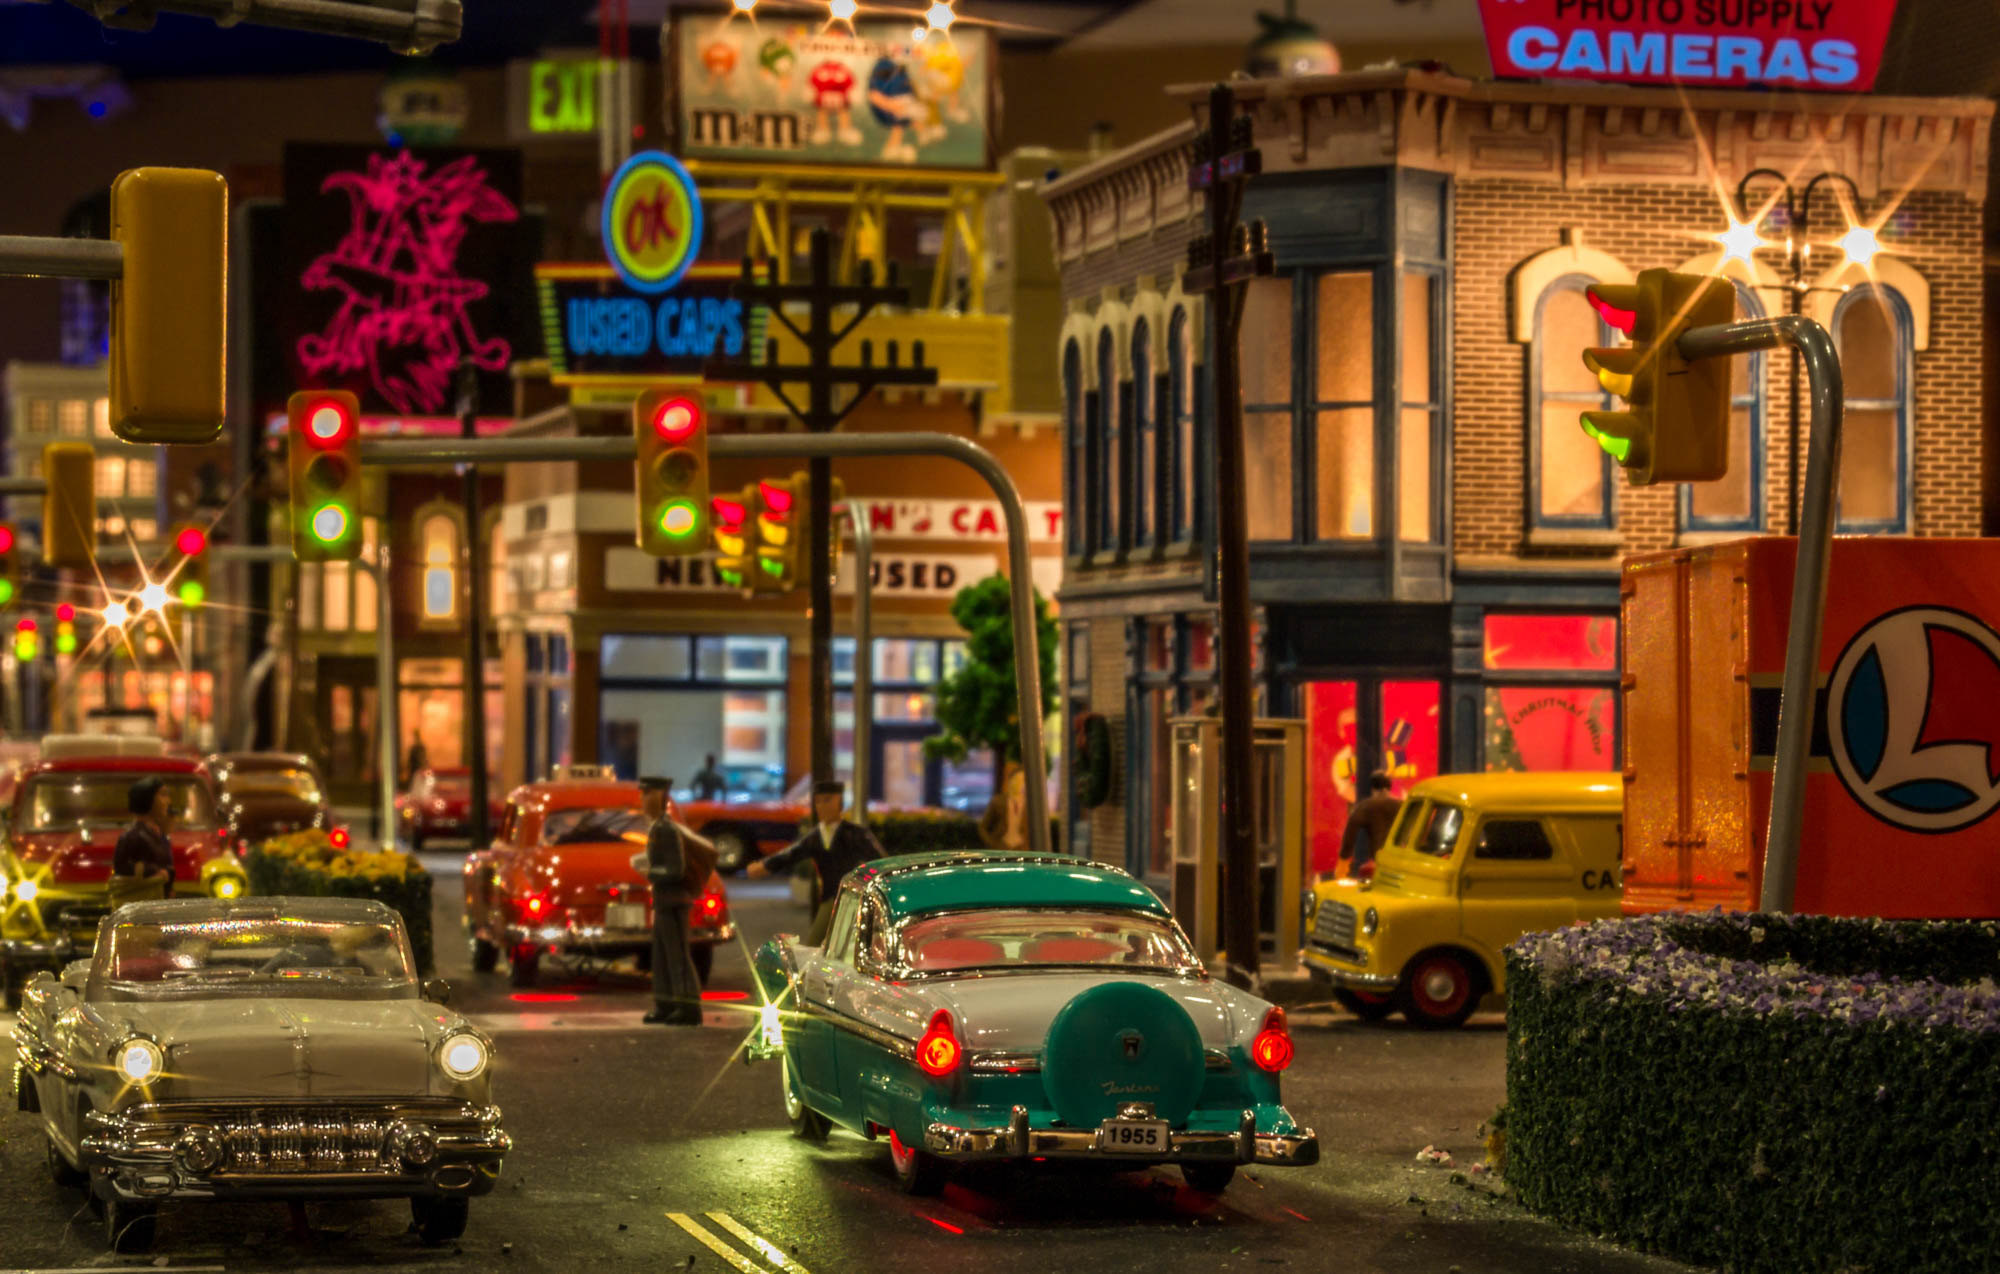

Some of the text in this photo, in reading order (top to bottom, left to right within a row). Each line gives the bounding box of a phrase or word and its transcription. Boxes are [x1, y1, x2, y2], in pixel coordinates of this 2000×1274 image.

[1695, 0, 1832, 30] SUPPLY
[1507, 25, 1859, 84] CAMERAS
[626, 180, 678, 254] OK
[567, 297, 651, 356] USED
[569, 768, 602, 779] TAXI
[1109, 1126, 1158, 1146] 1955
